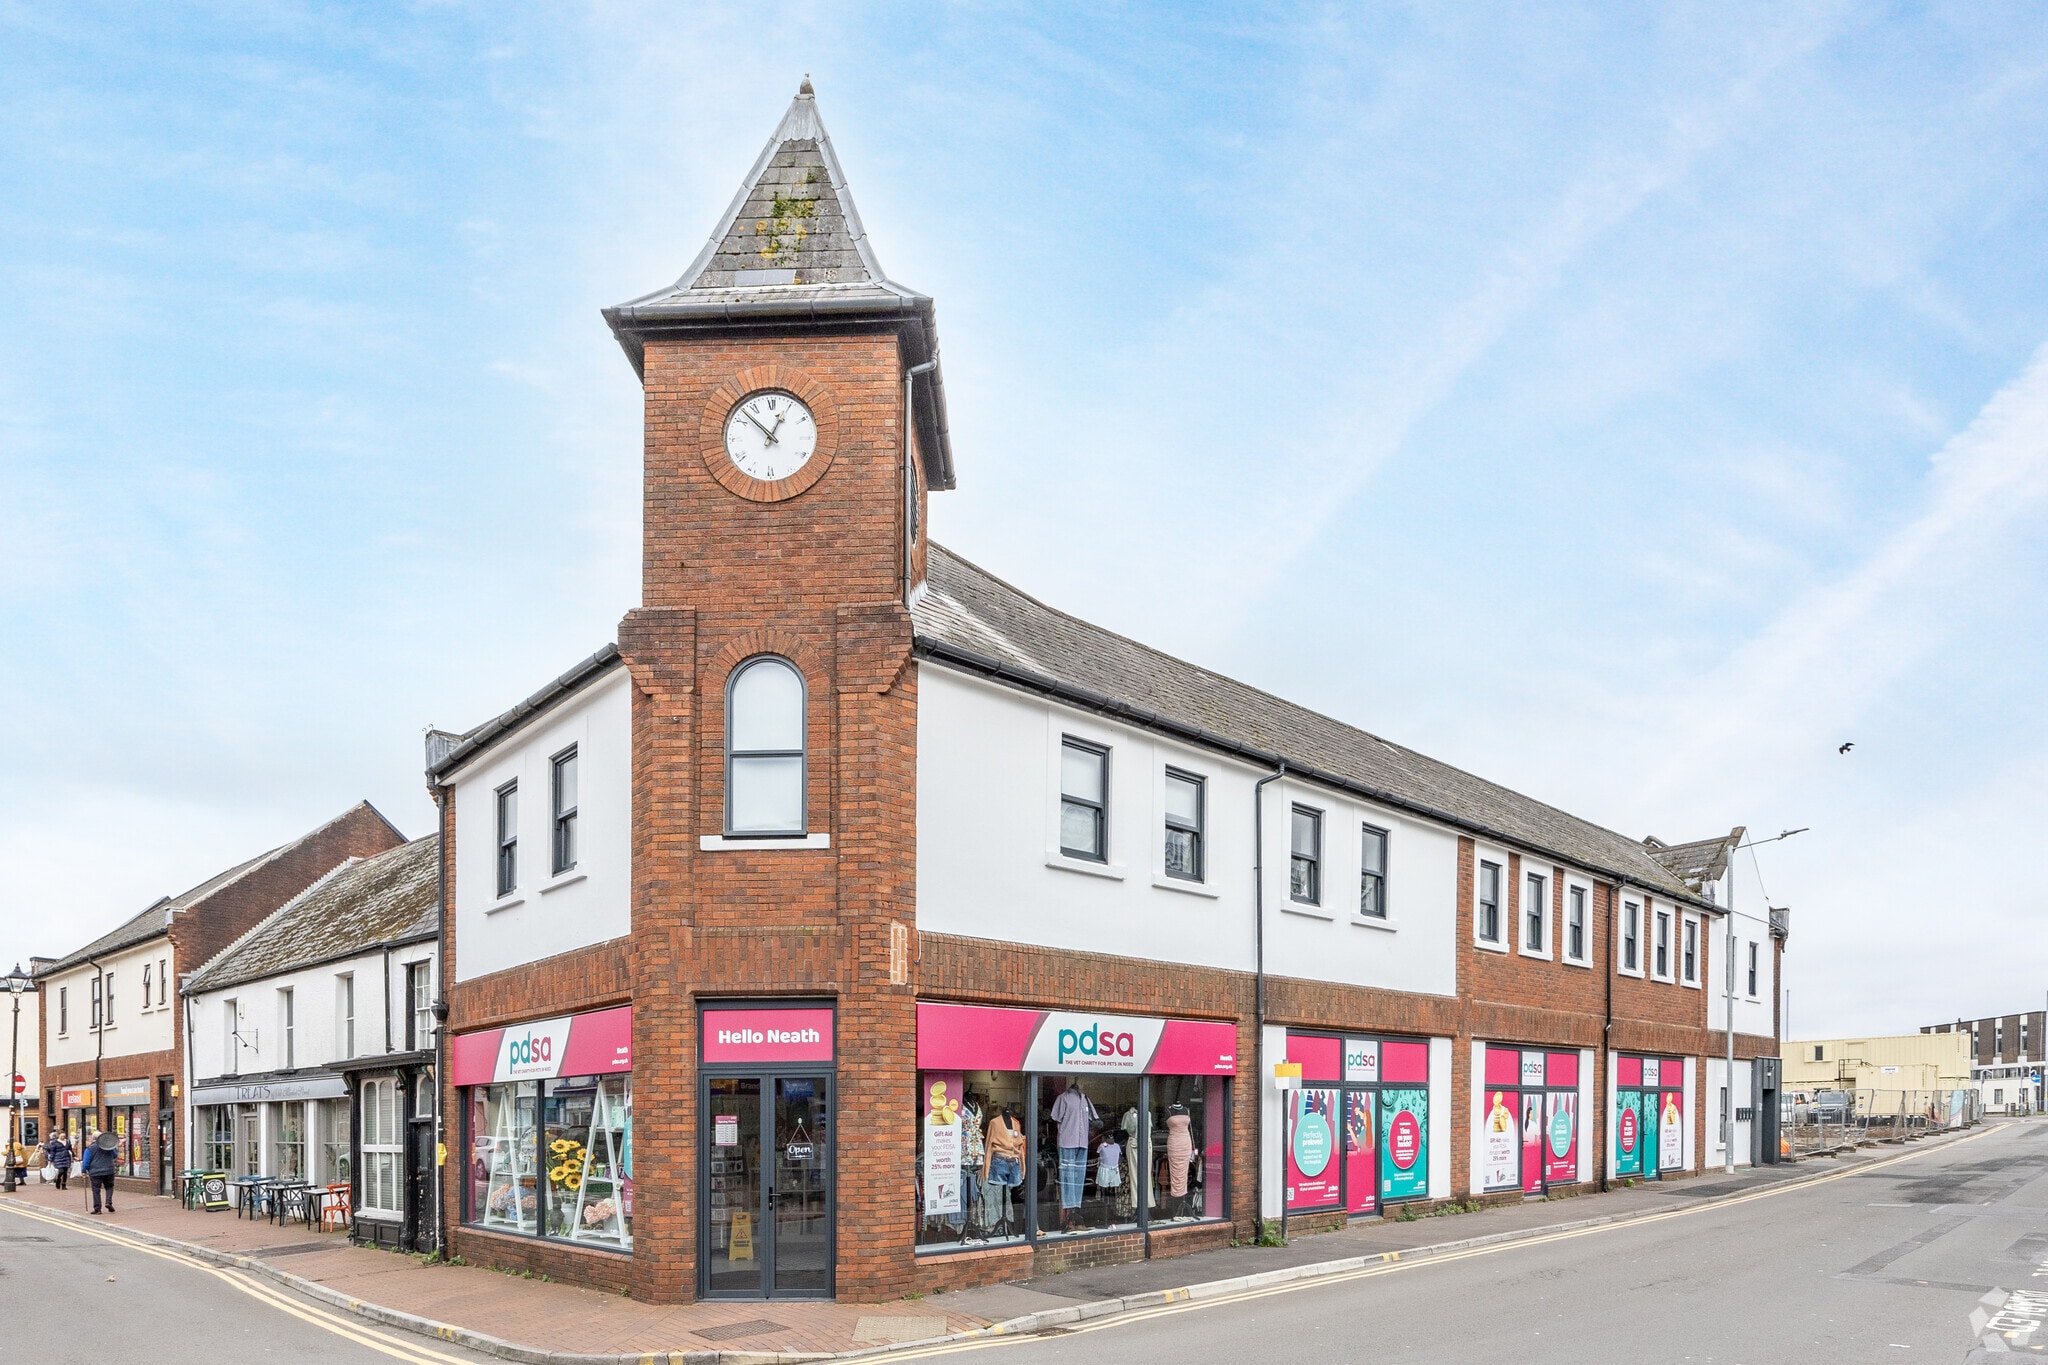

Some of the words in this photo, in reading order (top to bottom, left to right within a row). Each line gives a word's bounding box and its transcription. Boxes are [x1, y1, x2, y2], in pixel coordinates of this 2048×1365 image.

[718, 1029, 764, 1044] Hello
[767, 1028, 820, 1043] Neath
[1058, 1022, 1134, 1065] pdsa
[510, 1030, 552, 1075] pdsa
[1347, 1050, 1375, 1071] pdsa
[1523, 1059, 1542, 1076] pdsa
[236, 1085, 271, 1100] TREATS
[788, 1145, 812, 1155] Open
[1302, 1138, 1324, 1147] preloved
